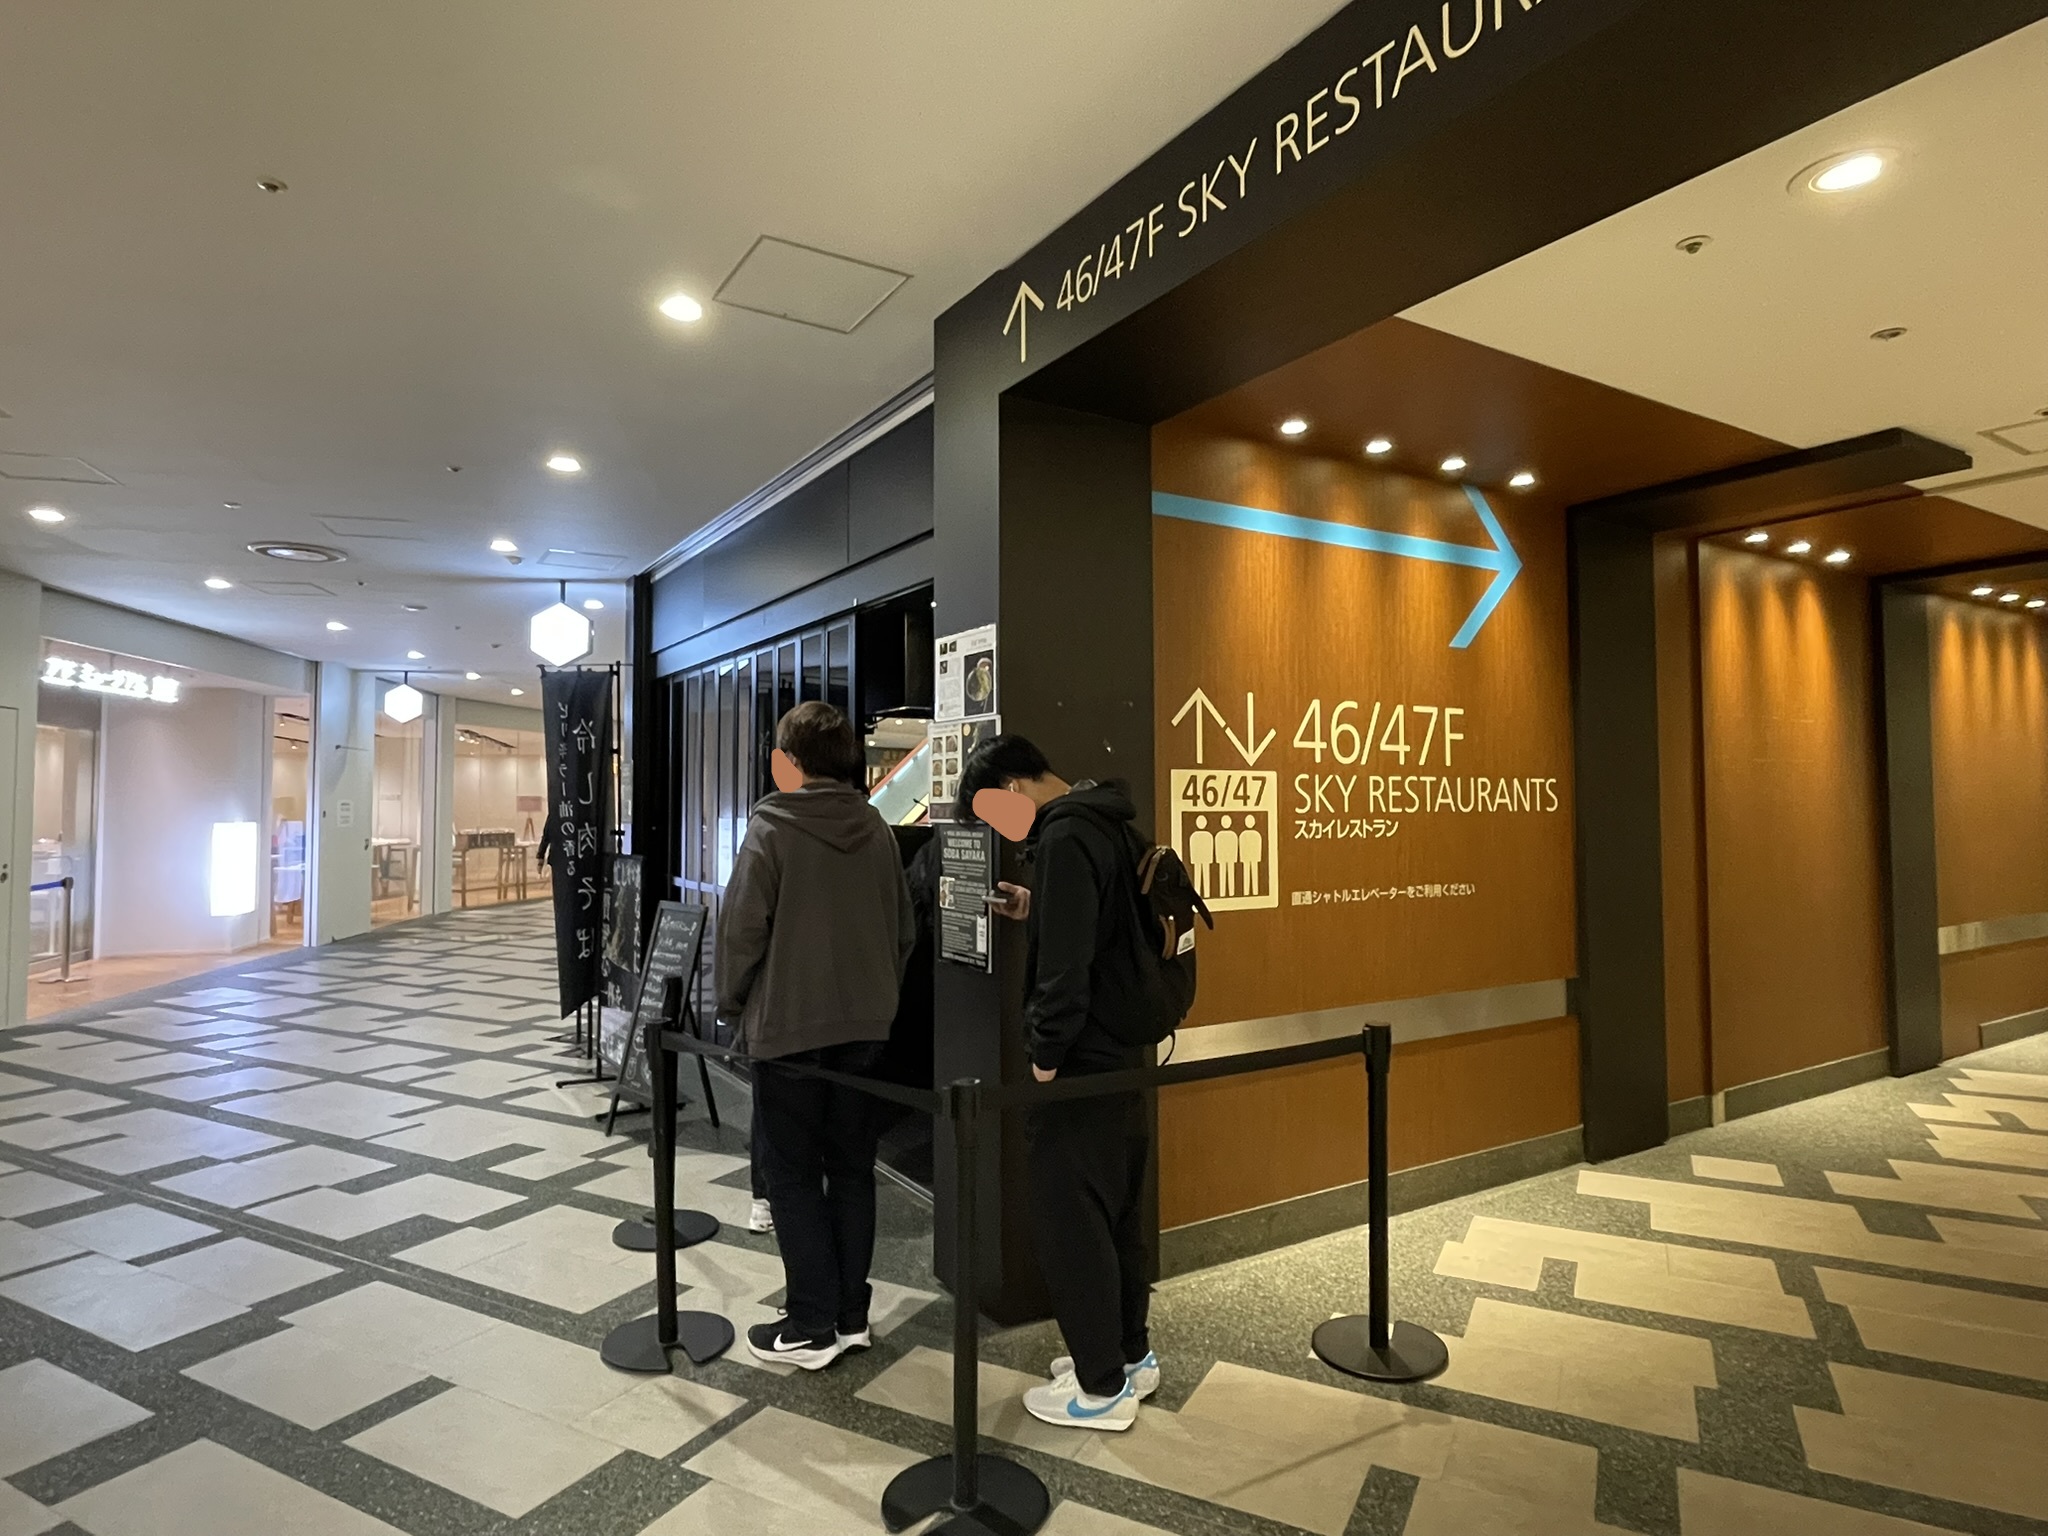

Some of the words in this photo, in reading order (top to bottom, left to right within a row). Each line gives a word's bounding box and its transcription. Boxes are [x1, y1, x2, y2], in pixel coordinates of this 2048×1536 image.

[1056, 203, 1165, 312] 46/47F
[1177, 136, 1258, 238] SKY
[1292, 698, 1466, 767] 46/47F
[1181, 773, 1268, 808] 46/47
[1294, 773, 1358, 814] SKY
[1368, 775, 1559, 814] RESTAURANTS
[1294, 818, 1399, 840] スカイレストラン
